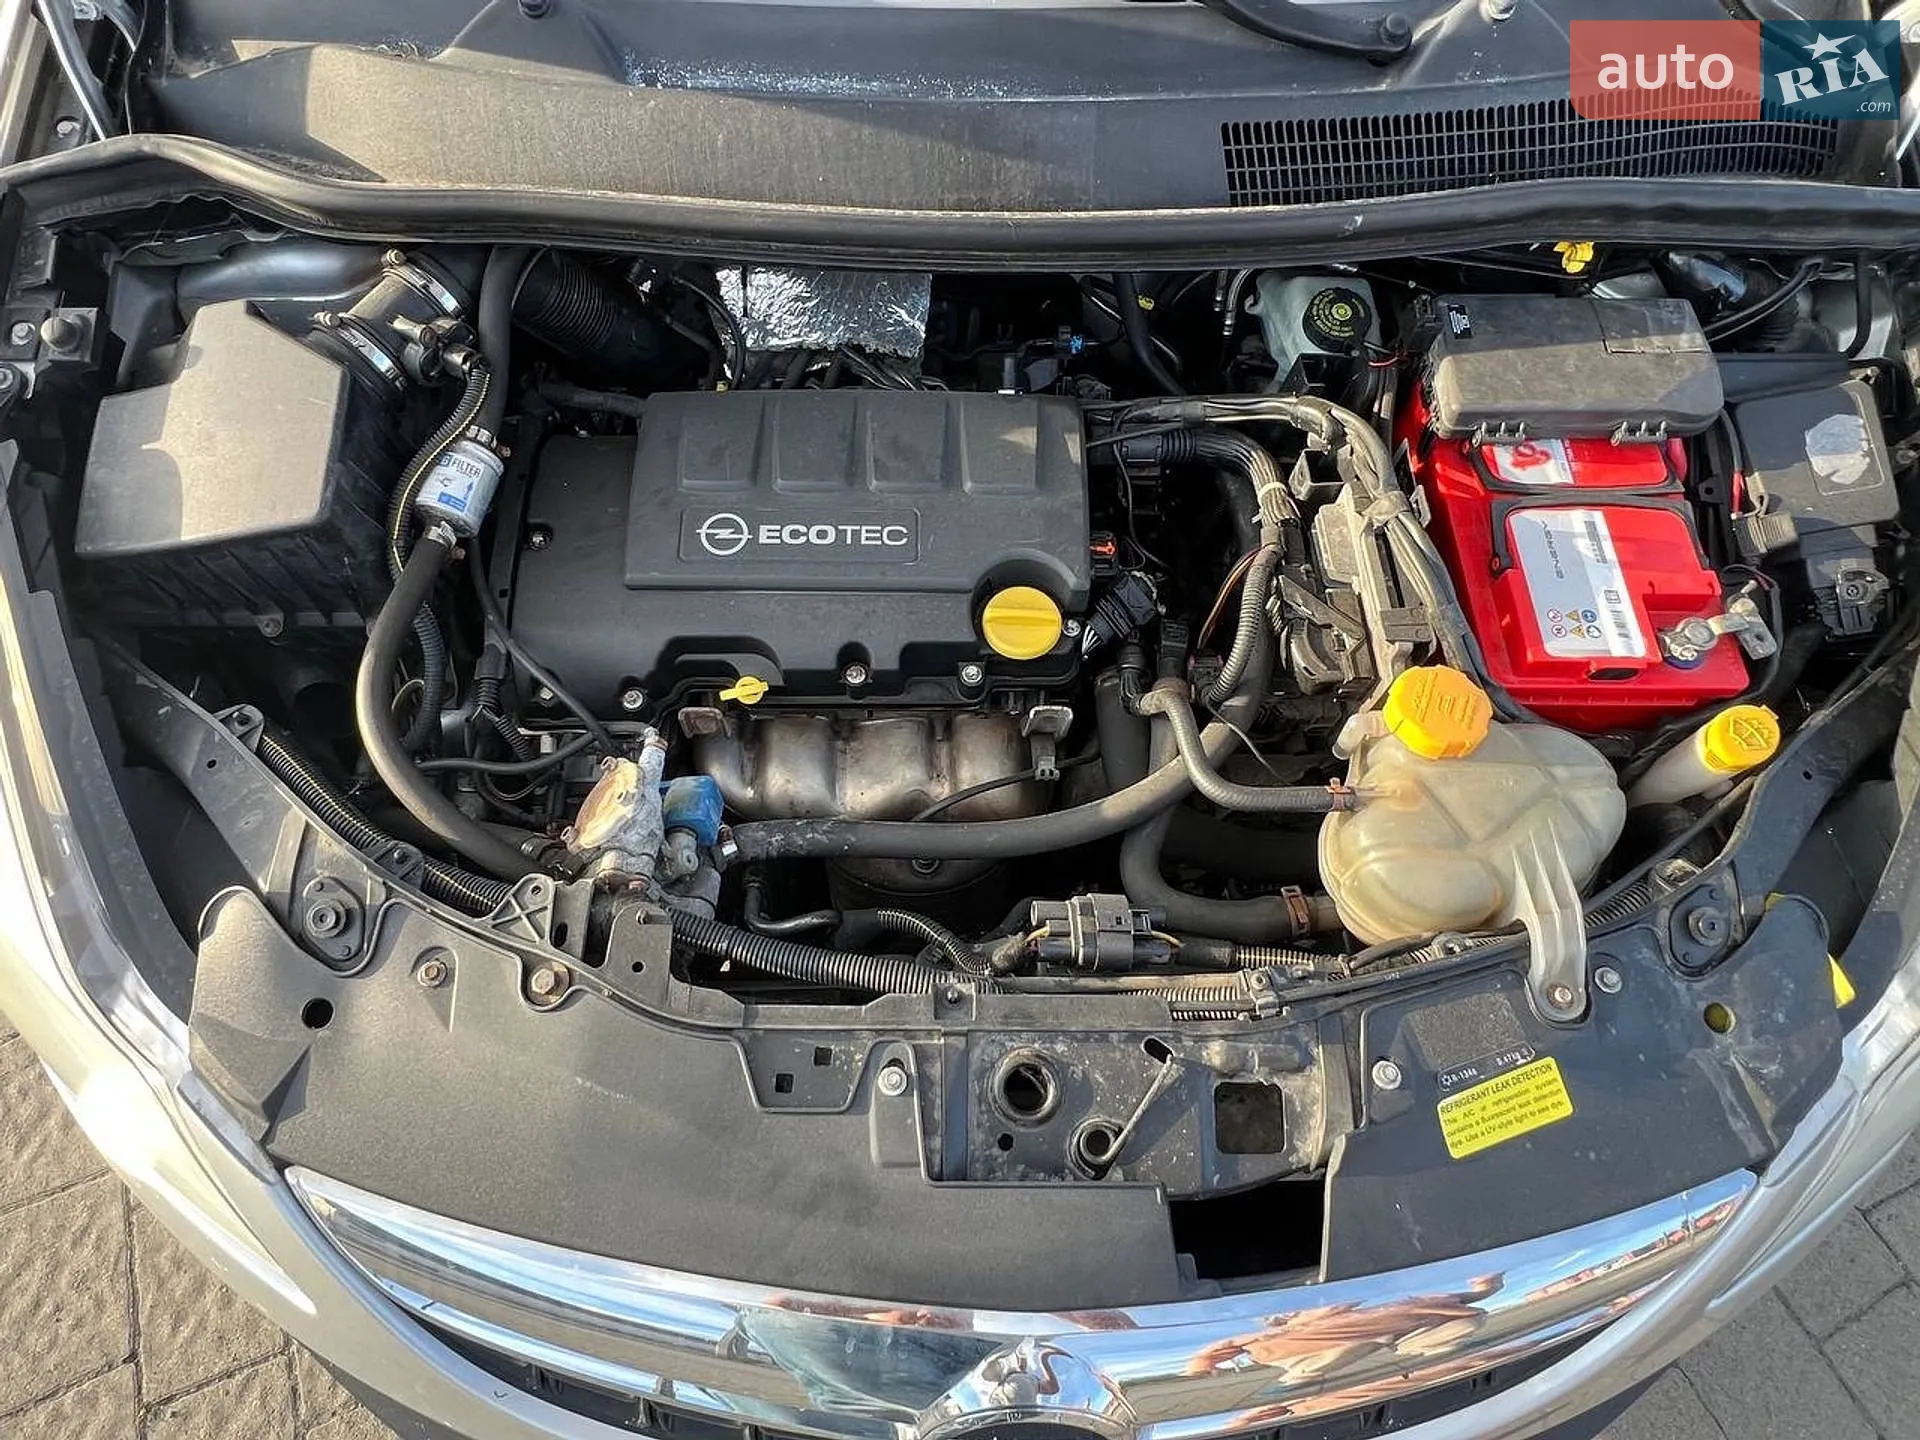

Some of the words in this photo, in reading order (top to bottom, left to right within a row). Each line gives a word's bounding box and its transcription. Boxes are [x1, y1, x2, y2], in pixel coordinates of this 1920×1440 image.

[452, 457, 481, 478] FILTER
[758, 524, 909, 546] ECOTEC
[1441, 1087, 1490, 1114] REFRIGERANT
[1491, 1079, 1512, 1094] LEAK
[1511, 1063, 1552, 1086] DETECTION
